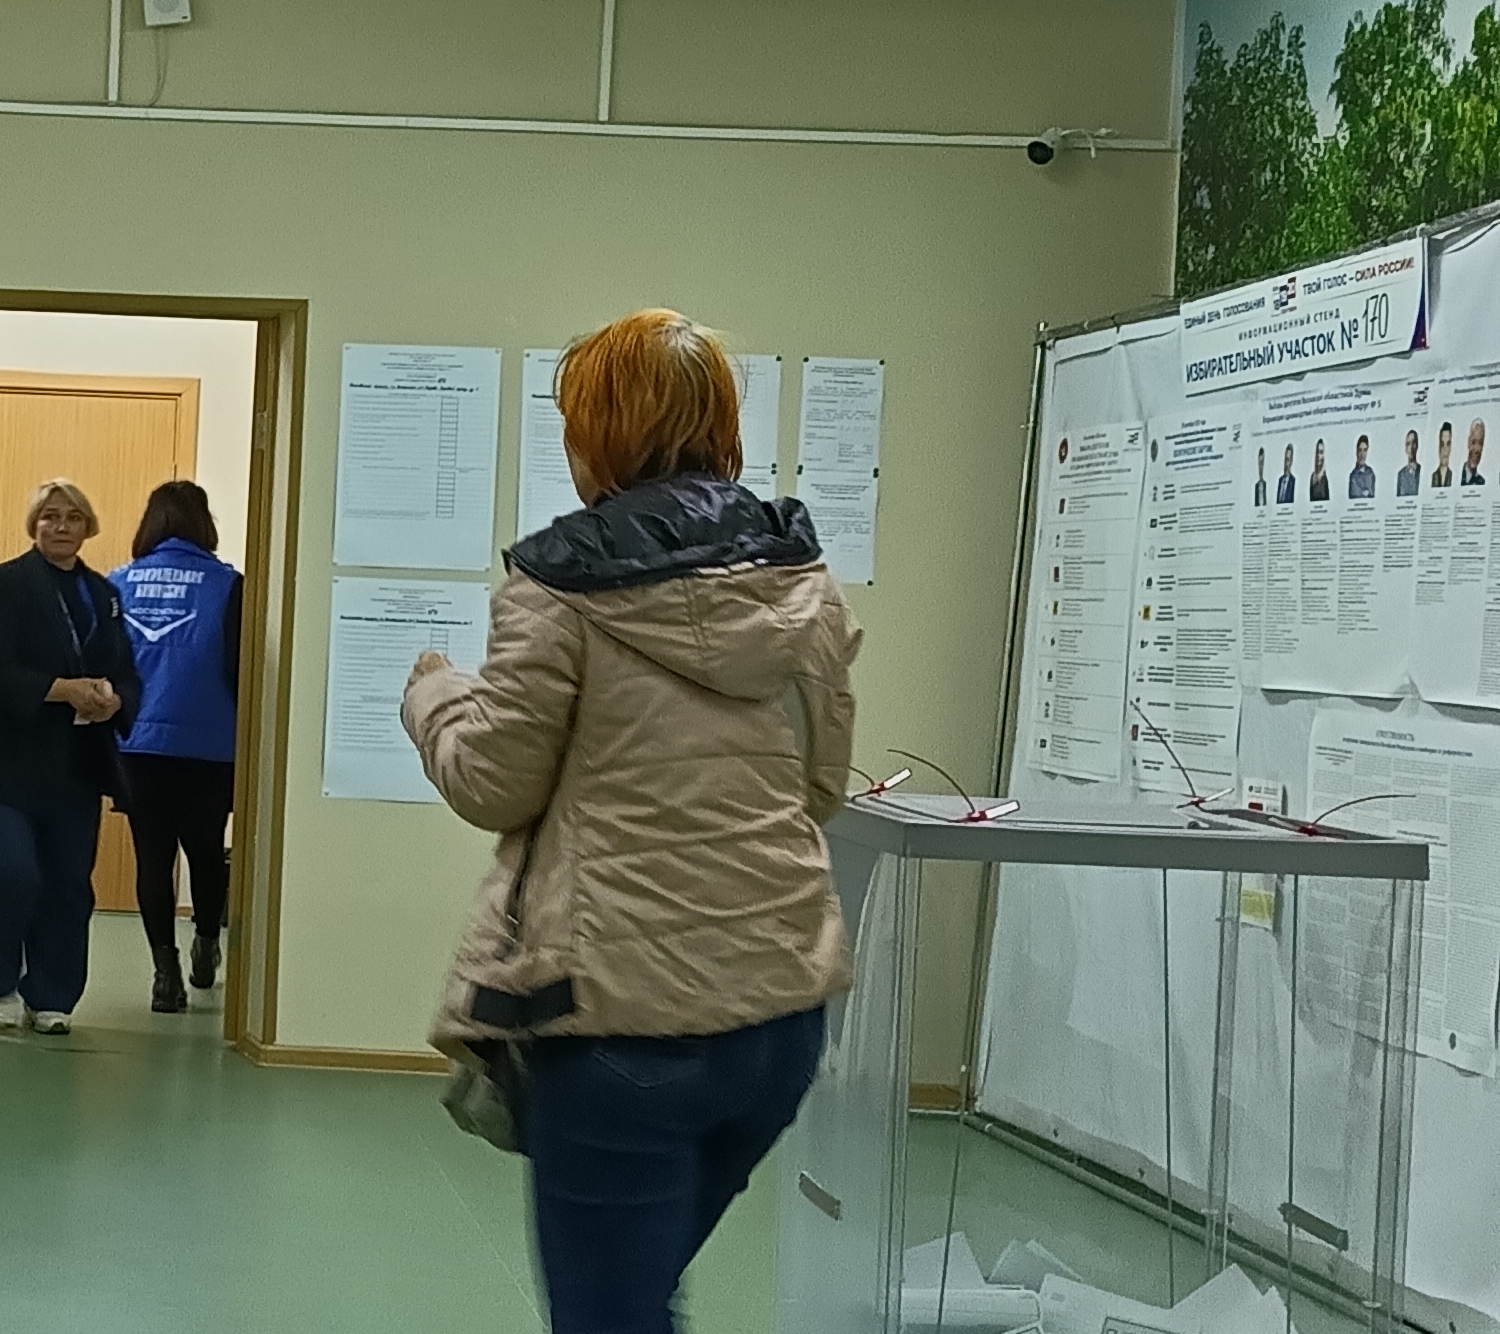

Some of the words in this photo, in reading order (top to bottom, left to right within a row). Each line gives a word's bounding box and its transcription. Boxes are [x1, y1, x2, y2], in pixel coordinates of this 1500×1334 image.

[1302, 276, 1322, 296] ТВОЙ
[1322, 272, 1348, 291] ГОЛОС
[1354, 266, 1378, 283] СИЛА
[1313, 307, 1341, 324] СТЕНД
[1185, 339, 1276, 384] ИЗБИРАТЕЛЬНЫЙ
[1276, 330, 1336, 364] УЧАСТОК
[1340, 317, 1360, 351] №
[1361, 292, 1390, 344] 170
